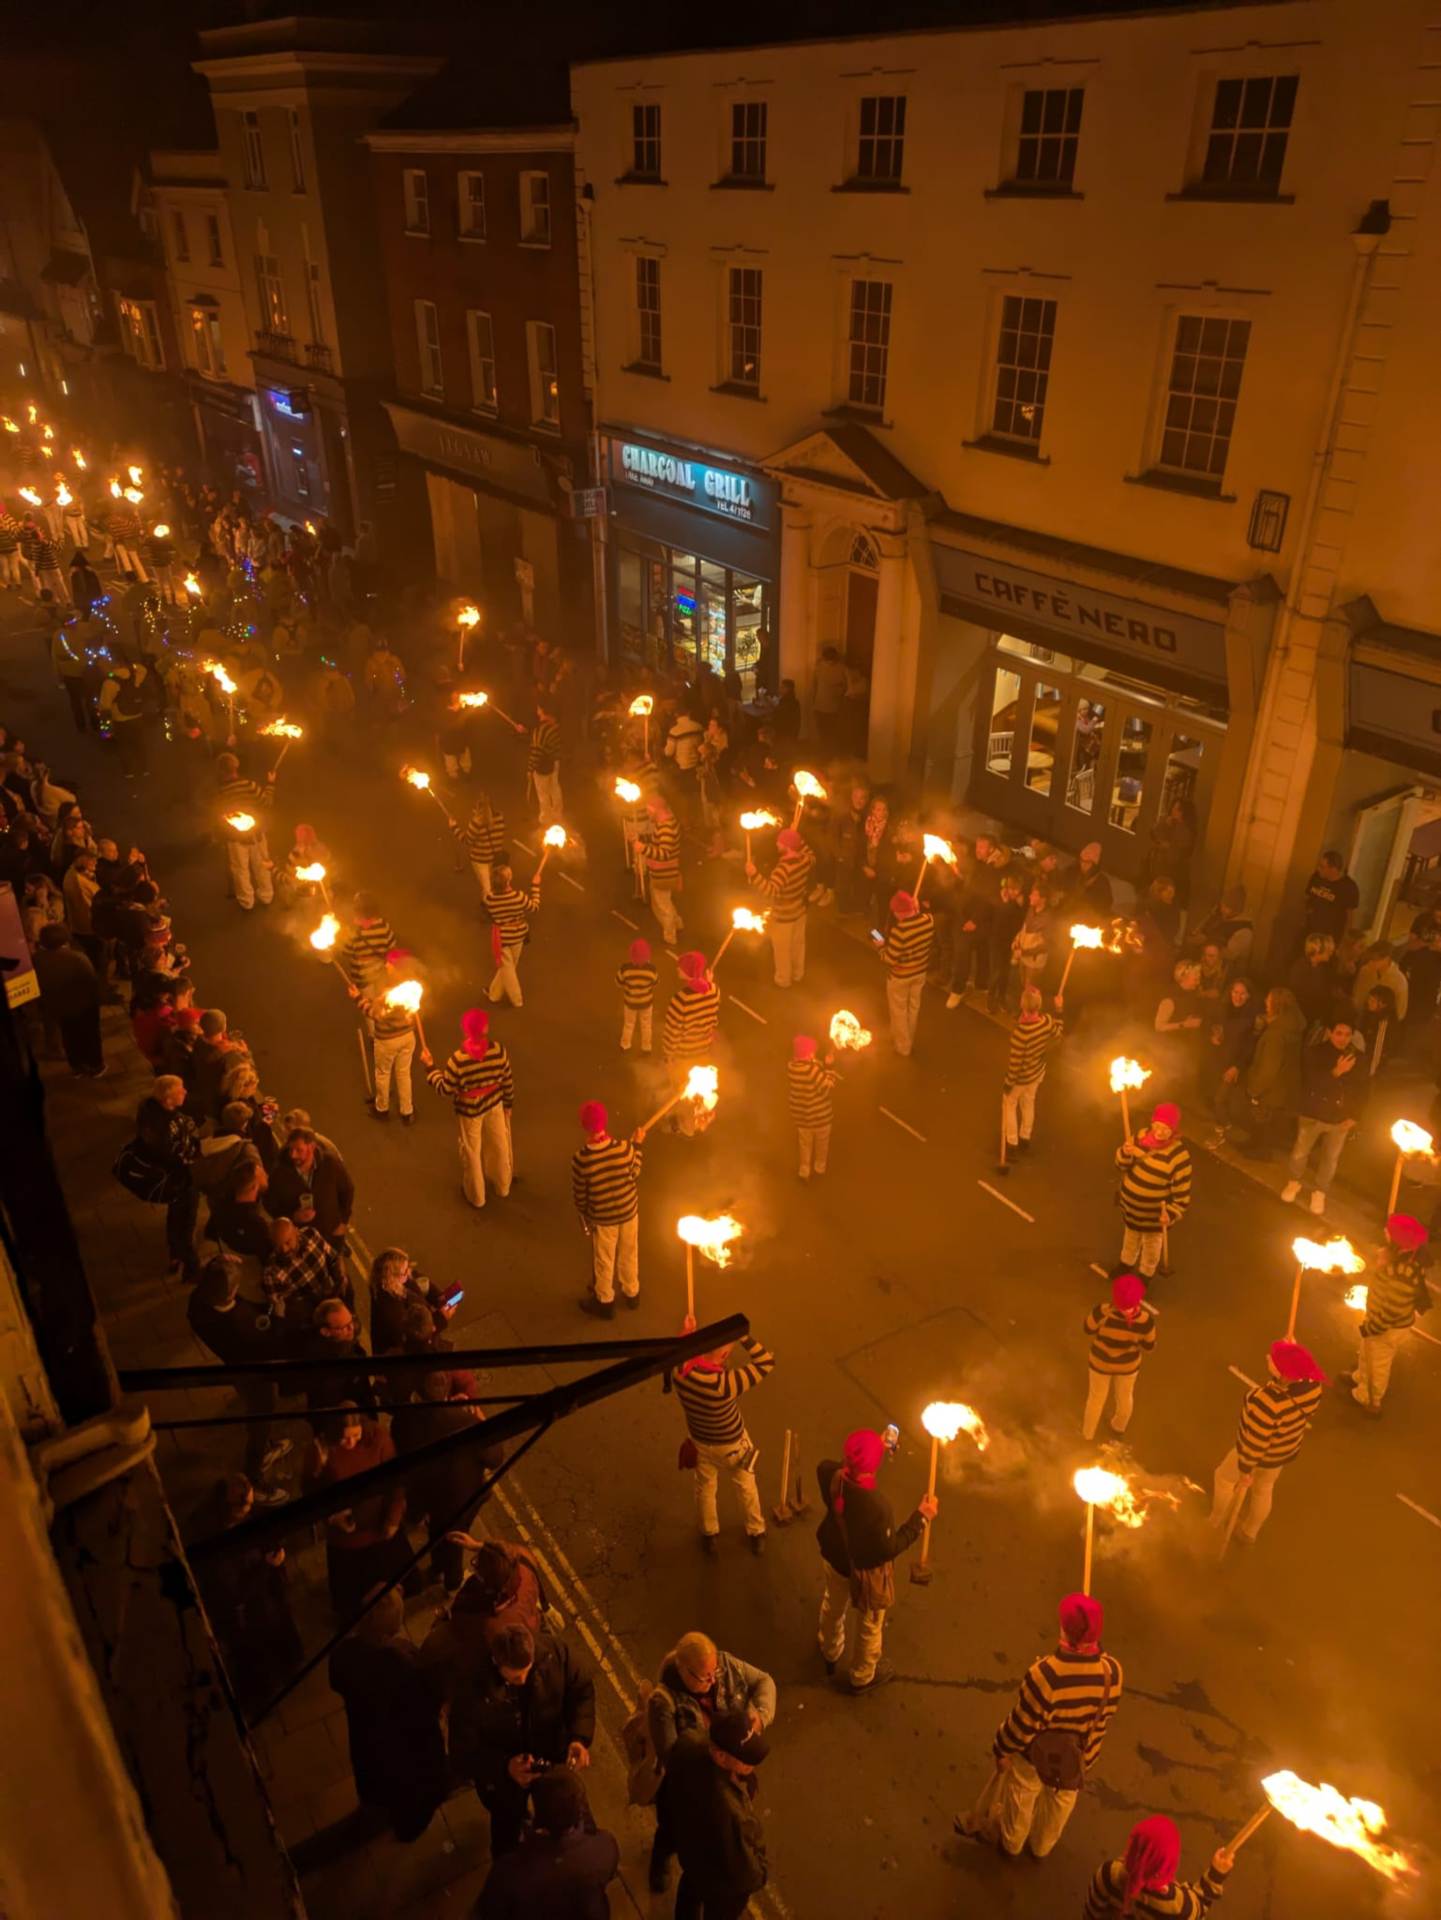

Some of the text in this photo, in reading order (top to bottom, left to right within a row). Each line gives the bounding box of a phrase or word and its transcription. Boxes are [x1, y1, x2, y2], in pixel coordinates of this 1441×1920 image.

[623, 445, 751, 506] CHARCOAL GRILL
[975, 573, 1176, 653] CAFFÈ NERO
